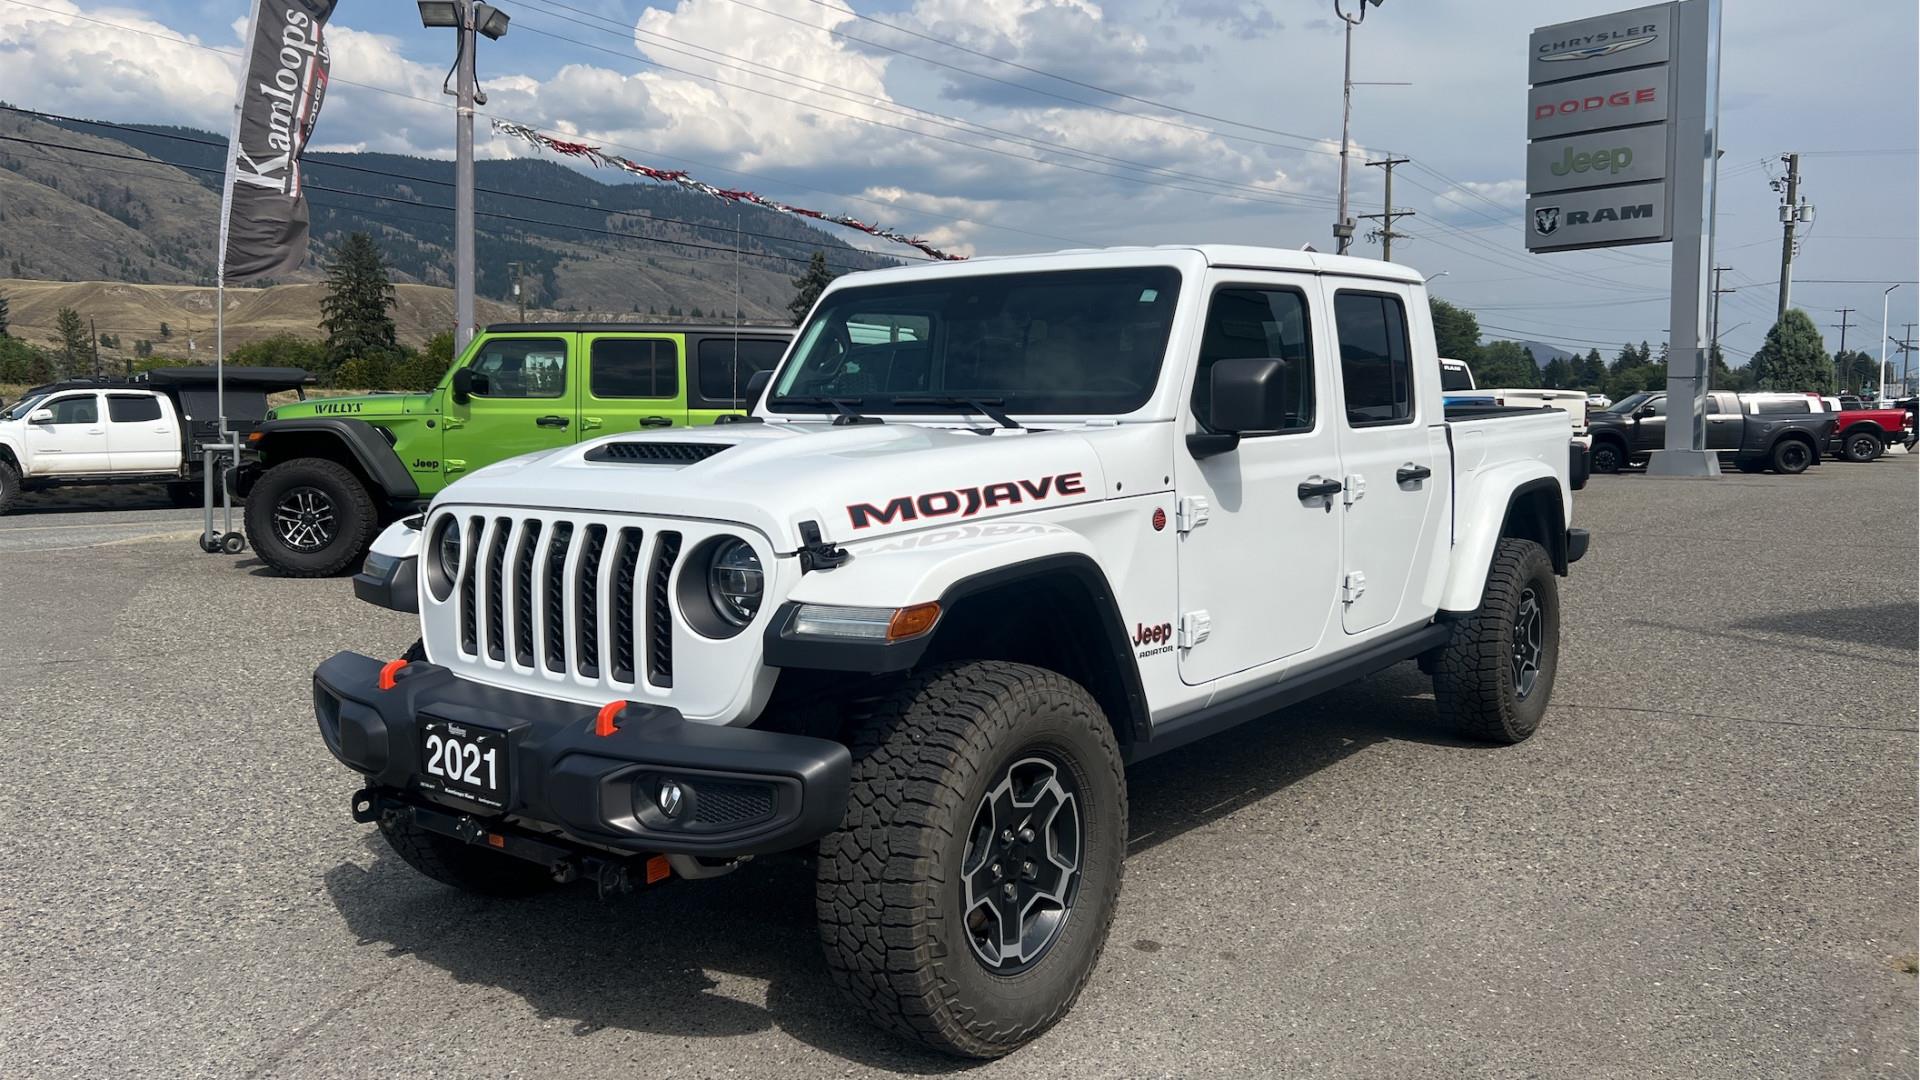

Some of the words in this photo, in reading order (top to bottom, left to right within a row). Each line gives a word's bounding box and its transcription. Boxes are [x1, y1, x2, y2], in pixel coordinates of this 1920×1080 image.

[1539, 24, 1657, 52] CHRYSLER
[235, 9, 318, 194] Kamloops
[1535, 87, 1656, 120] DODGE
[1551, 146, 1633, 176] Jeep
[1566, 203, 1653, 226] RAM
[315, 403, 363, 414] WILLYS
[413, 458, 439, 469] Jeep
[846, 471, 1087, 530] MOJAVE
[1132, 622, 1172, 647] Jeep
[426, 734, 497, 790] 2021
